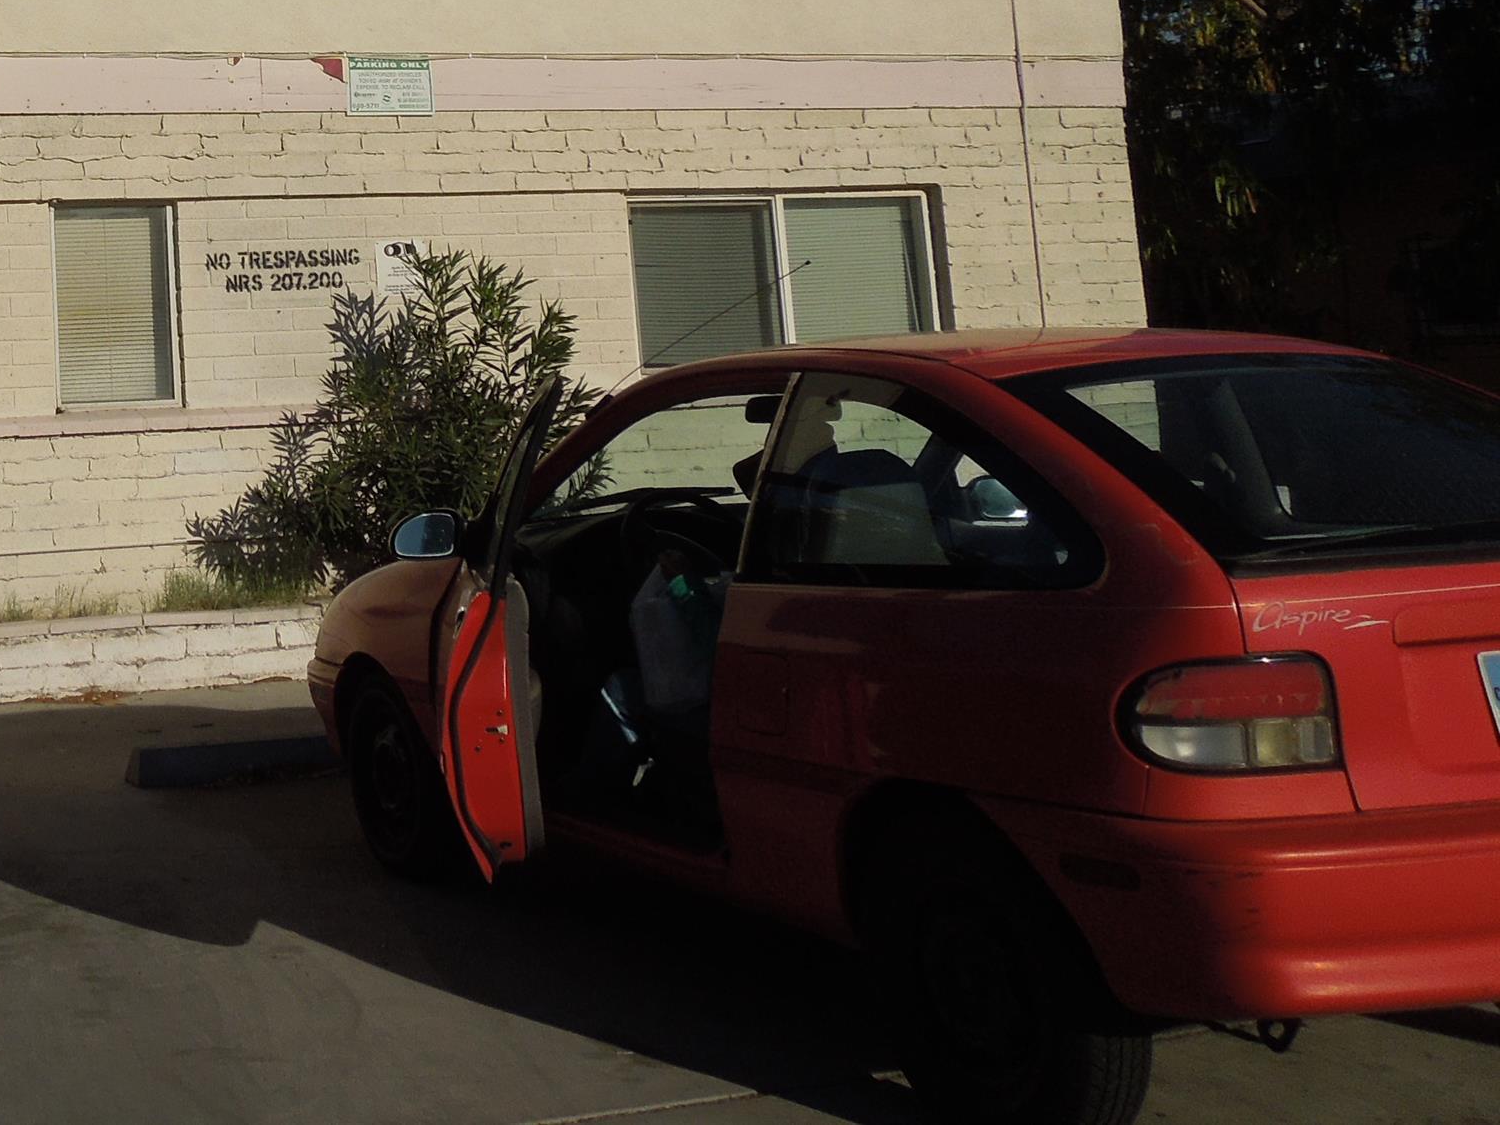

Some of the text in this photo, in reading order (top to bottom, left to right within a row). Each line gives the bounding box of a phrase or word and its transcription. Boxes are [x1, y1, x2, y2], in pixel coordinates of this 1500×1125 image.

[205, 249, 360, 271] NO TRESPASSING
[225, 271, 344, 293] NRS 207.200
[1253, 601, 1352, 636] Aspire
